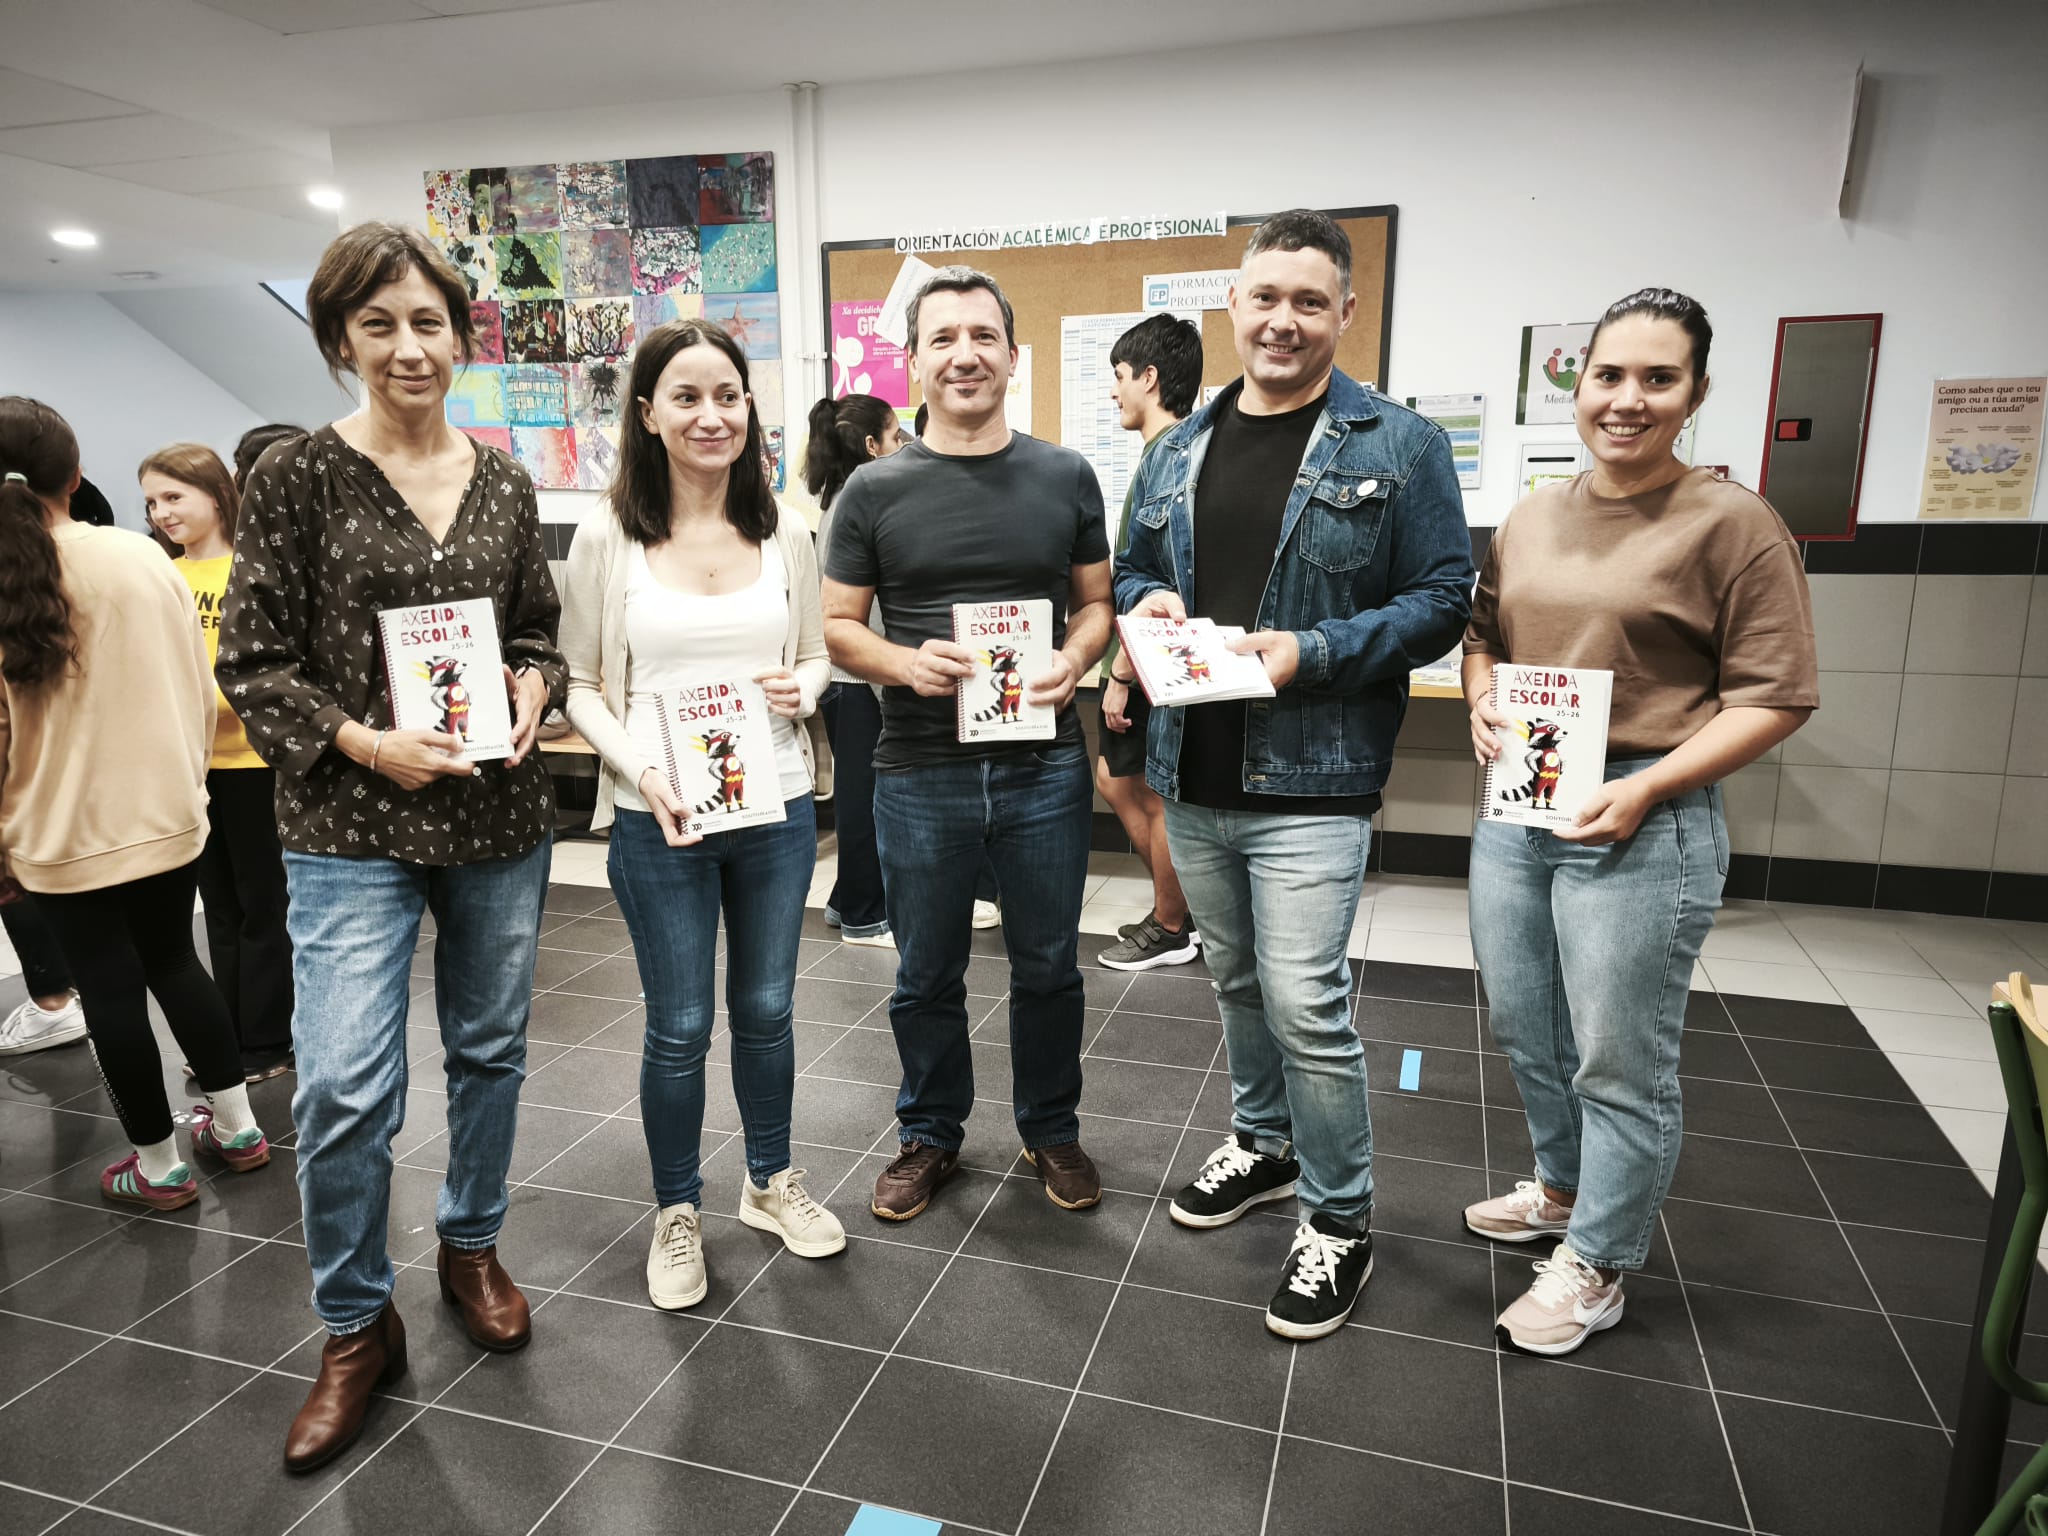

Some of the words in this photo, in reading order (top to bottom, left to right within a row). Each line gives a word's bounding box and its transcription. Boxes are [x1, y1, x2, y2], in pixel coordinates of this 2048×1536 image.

[897, 229, 999, 252] ORIENTACIÓN
[1002, 224, 1091, 247] ACADÉMICA
[1151, 289, 1167, 301] FP
[1938, 386, 1966, 395] Como
[1968, 385, 1994, 394] sabes
[1996, 386, 2014, 395] que
[2025, 385, 2041, 393] teu
[1937, 395, 1967, 405] amigo
[2010, 394, 2039, 404] amiga
[1950, 405, 1989, 415] precisan
[1991, 404, 2025, 413] axuda?
[401, 606, 466, 627] AXENDA
[971, 605, 1028, 619] AXENDA
[401, 624, 473, 646] ESCOLAR
[970, 621, 1031, 636] ESCOLAR
[1514, 670, 1578, 689] AXENDA
[678, 682, 740, 705] AXENDA
[1509, 689, 1581, 709] ESCOLAR
[678, 699, 746, 722] ESCOLAR
[1556, 710, 1580, 718] 25-26
[726, 714, 747, 724] 25-26
